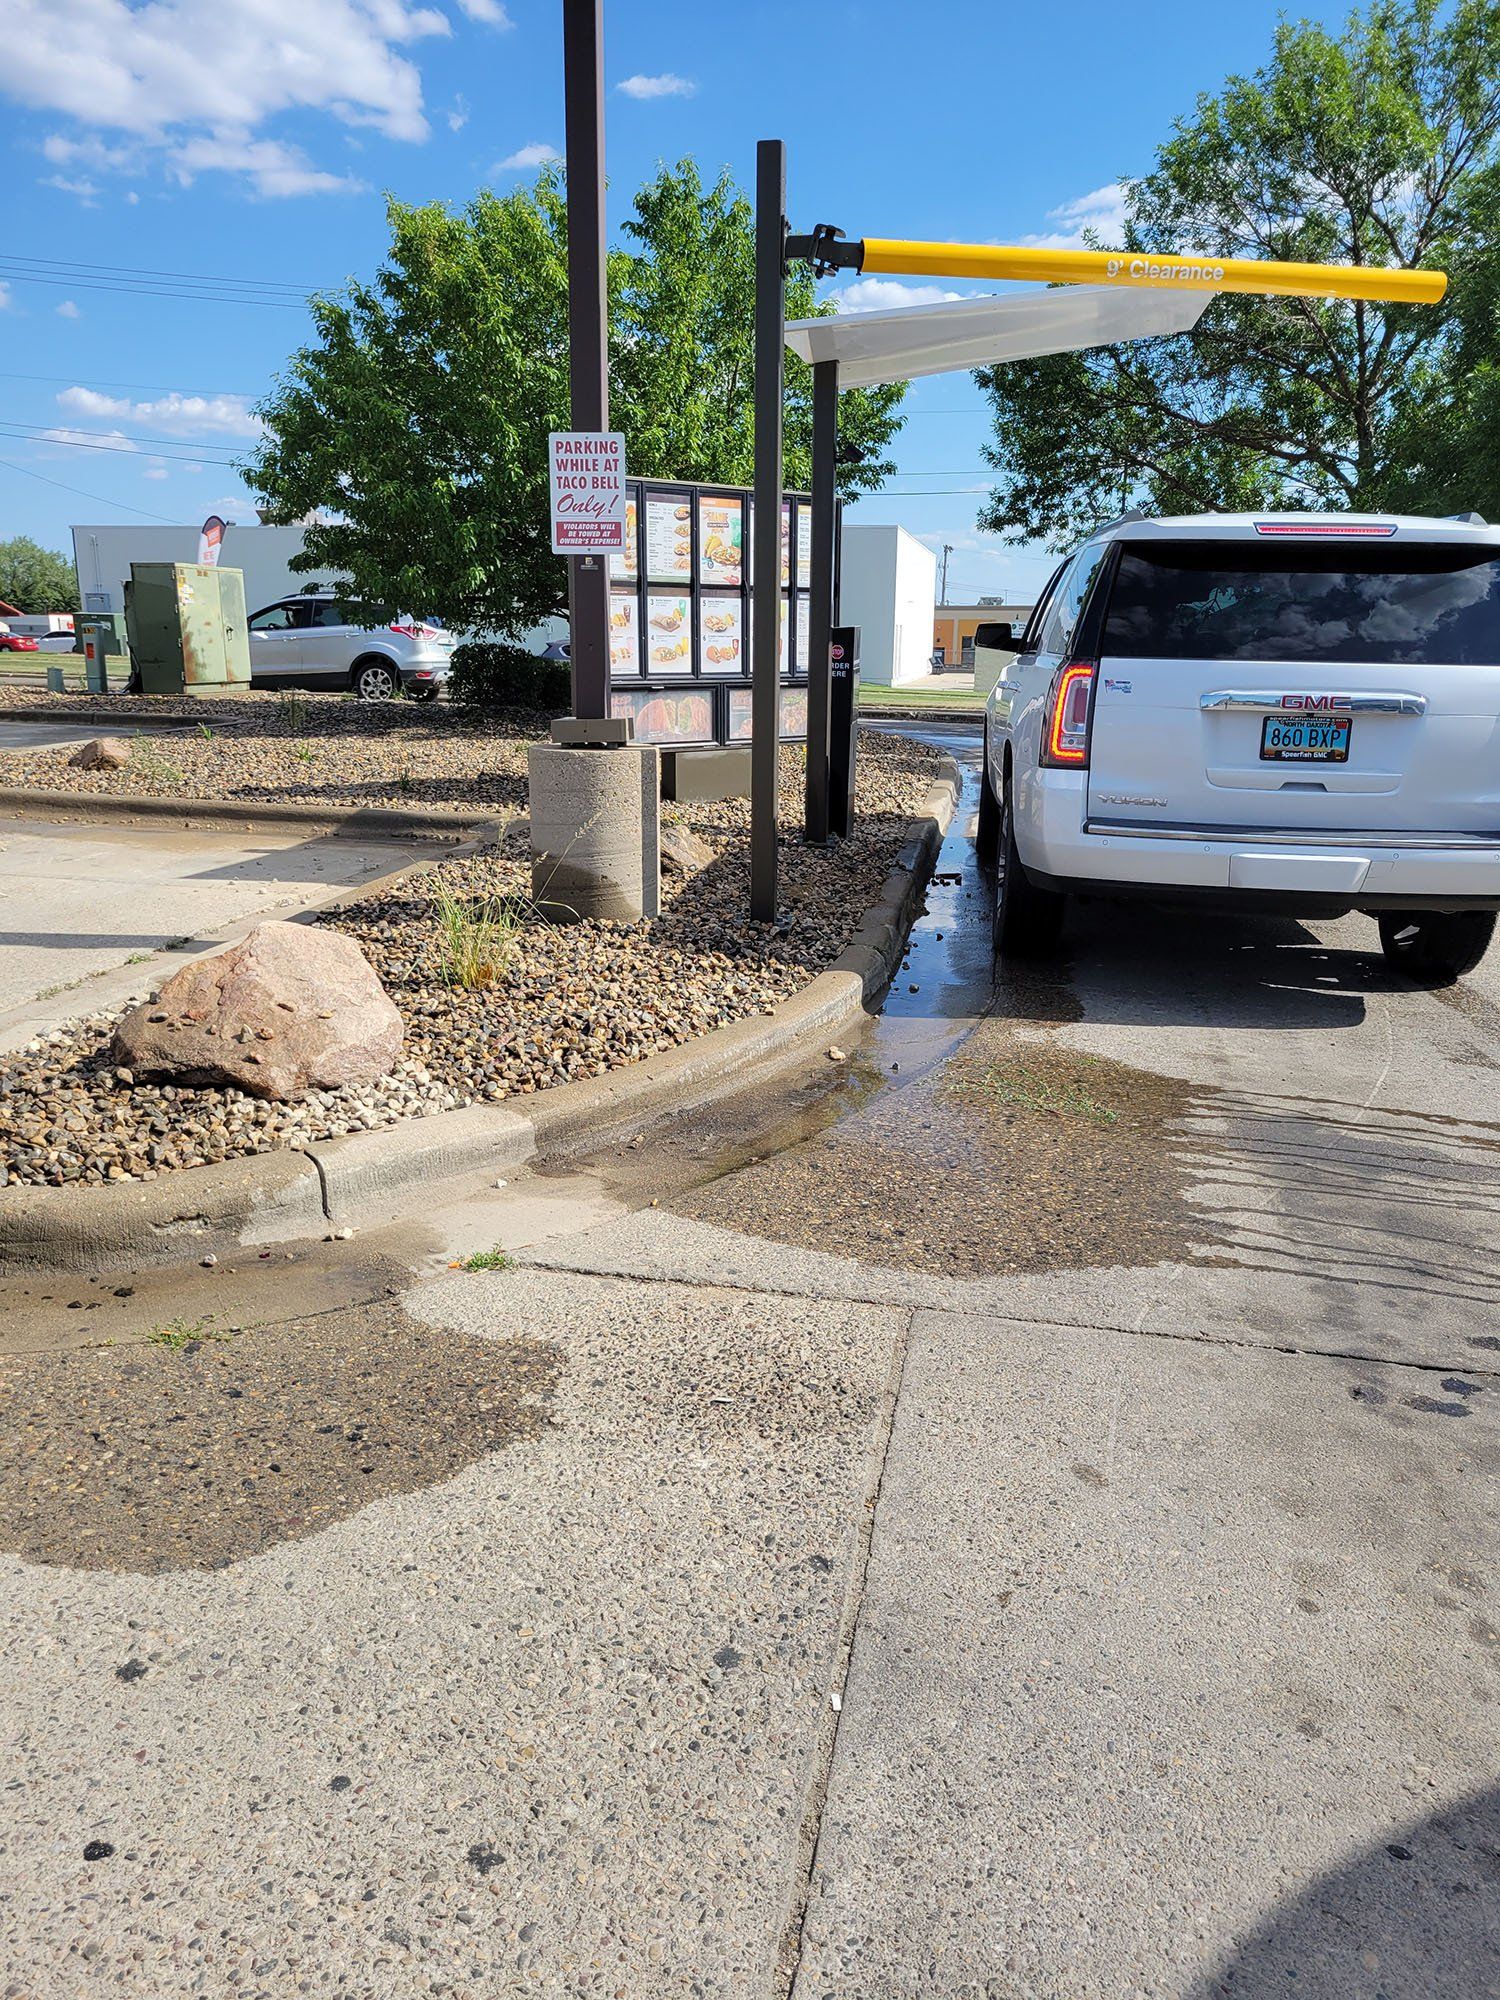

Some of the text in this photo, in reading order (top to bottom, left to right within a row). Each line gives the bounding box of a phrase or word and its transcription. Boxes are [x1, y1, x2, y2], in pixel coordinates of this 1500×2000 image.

[1106, 259, 1225, 281] 9' Clearance
[555, 440, 619, 454] PARKING
[556, 459, 620, 472] WHILE AT
[556, 476, 620, 490] TACO BELL
[557, 493, 620, 519] Only!
[831, 670, 847, 678] ERE
[1281, 695, 1351, 711] GMC
[1271, 728, 1340, 748] 860 BXP
[1097, 794, 1168, 807] YUKON
